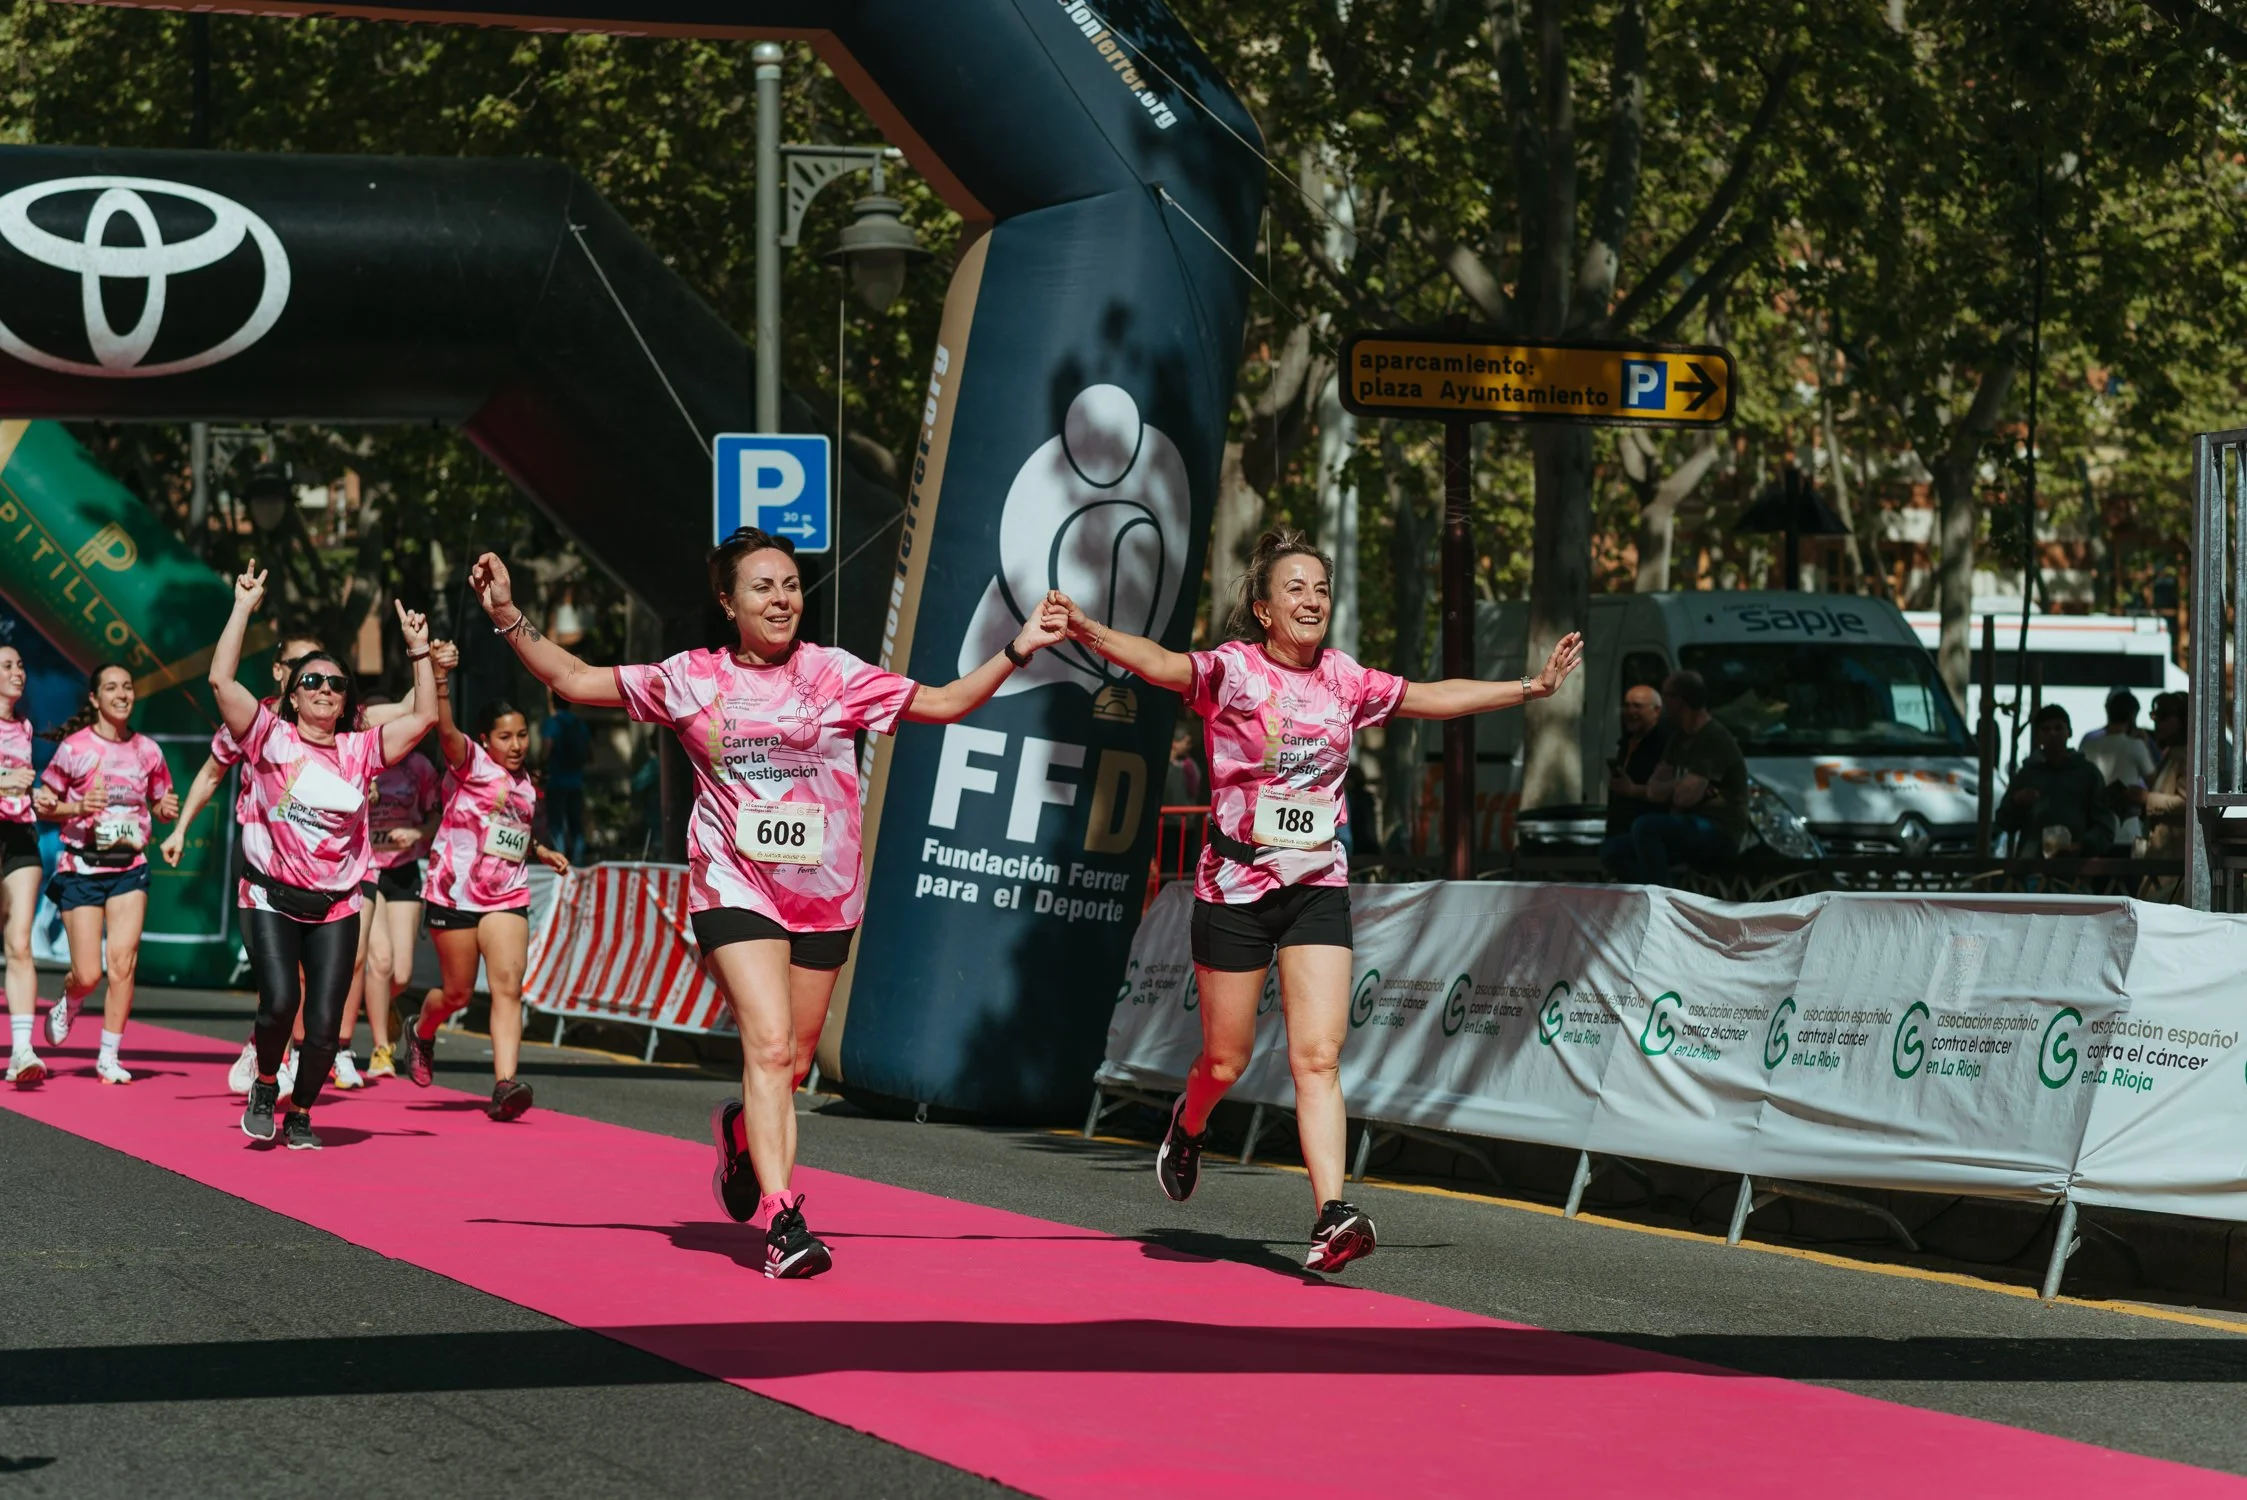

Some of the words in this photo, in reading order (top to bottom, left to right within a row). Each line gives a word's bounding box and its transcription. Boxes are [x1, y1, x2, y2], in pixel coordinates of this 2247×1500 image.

[1359, 351, 1534, 376] aparcamiento:
[1359, 377, 1422, 401] plaza
[1440, 381, 1609, 406] Ayuntamiento
[1628, 364, 1659, 406] P
[739, 448, 806, 529] P
[783, 511, 798, 522] 30
[1738, 605, 1869, 637] sapje
[723, 719, 737, 731] XI
[1282, 717, 1293, 729] XI
[721, 735, 779, 748] Carrera
[1281, 733, 1328, 747] Carrera
[723, 754, 748, 767] por
[751, 751, 766, 764] la
[1280, 751, 1300, 764] por
[728, 765, 818, 782] Investigación
[928, 723, 1148, 854] FFD
[290, 802, 308, 812] por
[1275, 807, 1314, 834] 188
[496, 830, 525, 851] 5441
[757, 819, 806, 847] 608
[921, 837, 1061, 884] Fundación
[1067, 862, 1130, 892] Ferrer
[915, 872, 979, 903] para
[993, 885, 1022, 910] el
[1034, 888, 1124, 923] Deporte
[1733, 1005, 1770, 1023] española
[1803, 1006, 1850, 1023] asociación
[1851, 1008, 1893, 1028] española
[1937, 1009, 1992, 1030] asociación
[1992, 1013, 2040, 1033] española
[1682, 1023, 1709, 1036] contra
[1710, 1025, 1720, 1039] el
[1720, 1025, 1749, 1041] cáncer
[1797, 1028, 1828, 1044] contra
[1827, 1029, 1836, 1045] el
[1837, 1028, 1869, 1047] cáncer
[1674, 1046, 1686, 1056] en
[1687, 1043, 1699, 1057] La
[1699, 1043, 1721, 1061] Rioja
[1932, 1034, 1967, 1051] contra
[1968, 1036, 1978, 1053] el
[1978, 1034, 2013, 1055] cáncer
[1791, 1054, 1803, 1065] en
[1804, 1051, 1817, 1067] La
[1817, 1051, 1841, 1069] Rioja
[2127, 1044, 2144, 1063] el
[2146, 1048, 2209, 1071] cáncer
[1925, 1061, 1939, 1075] en
[1940, 1059, 1955, 1076] La
[1956, 1058, 1981, 1082] Rioja
[2111, 1068, 2154, 1094] Rioja
